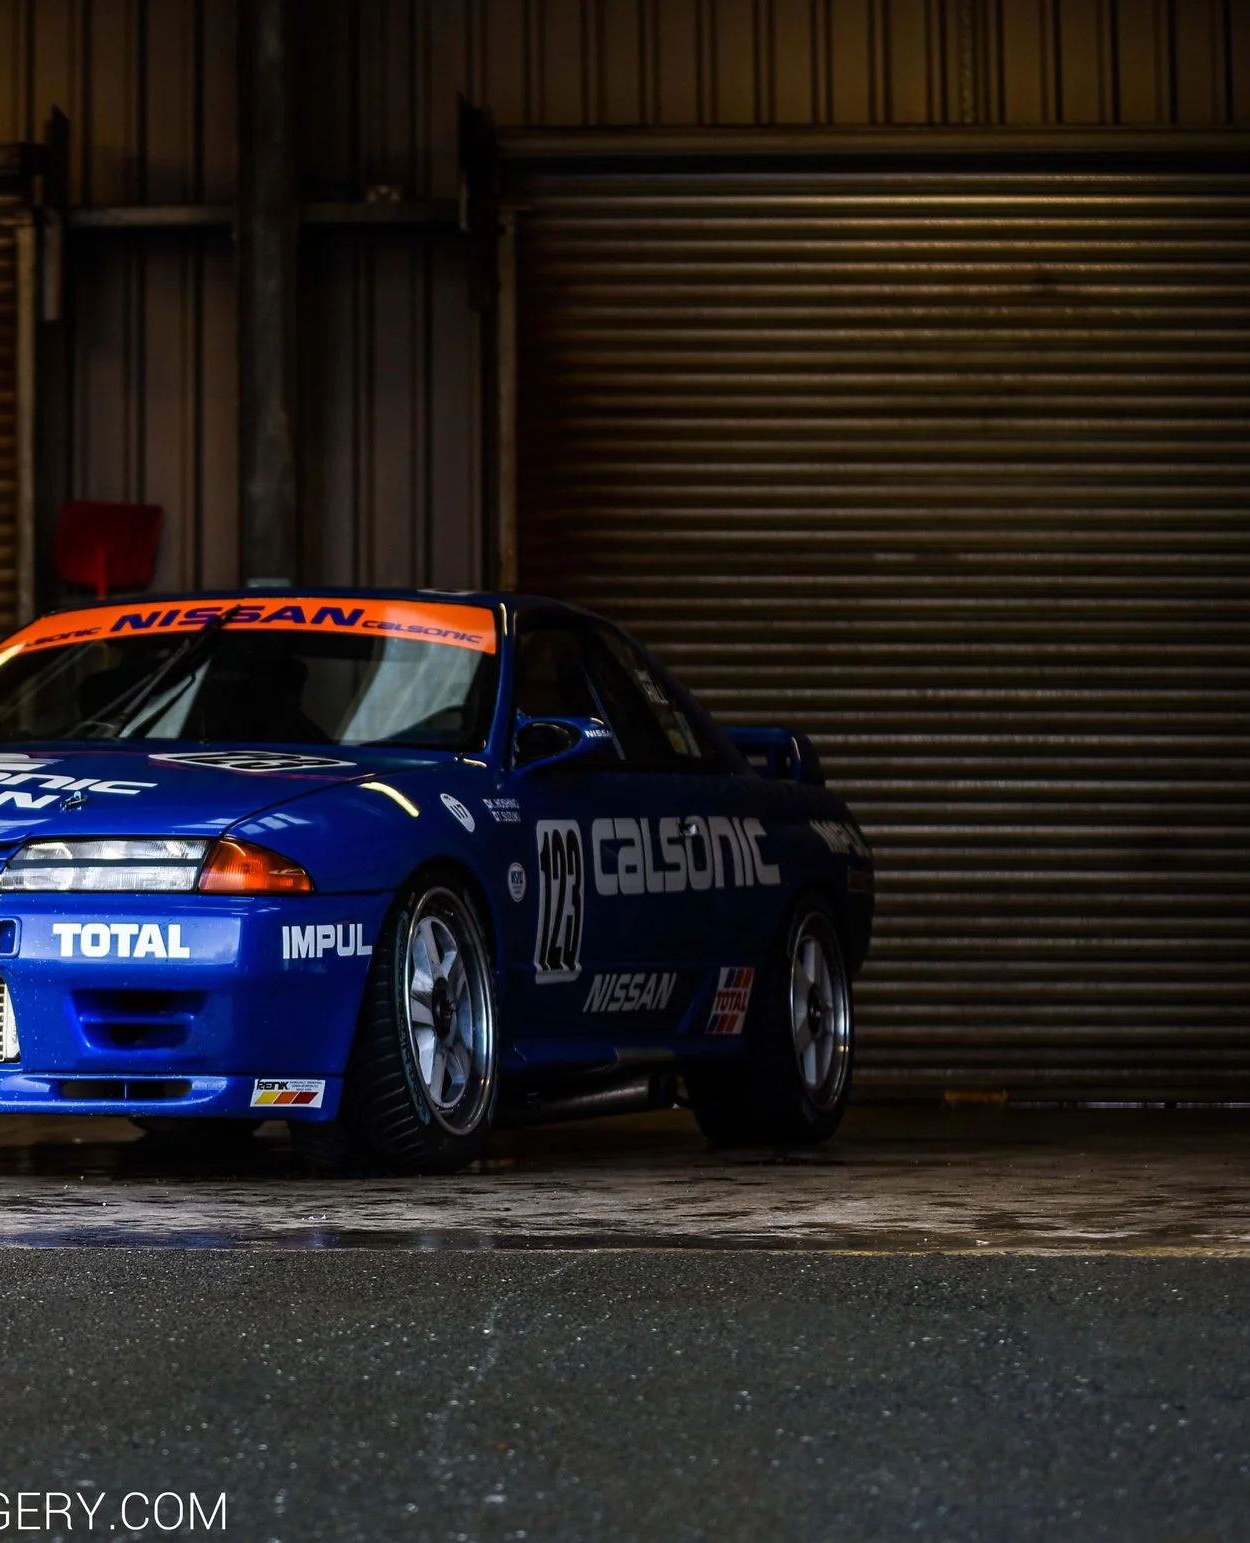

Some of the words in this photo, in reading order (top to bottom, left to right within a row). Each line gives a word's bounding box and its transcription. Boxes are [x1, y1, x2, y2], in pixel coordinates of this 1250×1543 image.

[110, 606, 365, 632] NISSAN
[585, 730, 613, 738] NISSA
[540, 829, 581, 971] 123
[52, 923, 190, 958] TOTAL
[282, 923, 373, 959] IMPUL
[582, 971, 677, 1013] NISSAN
[714, 991, 748, 1012] TOTAL
